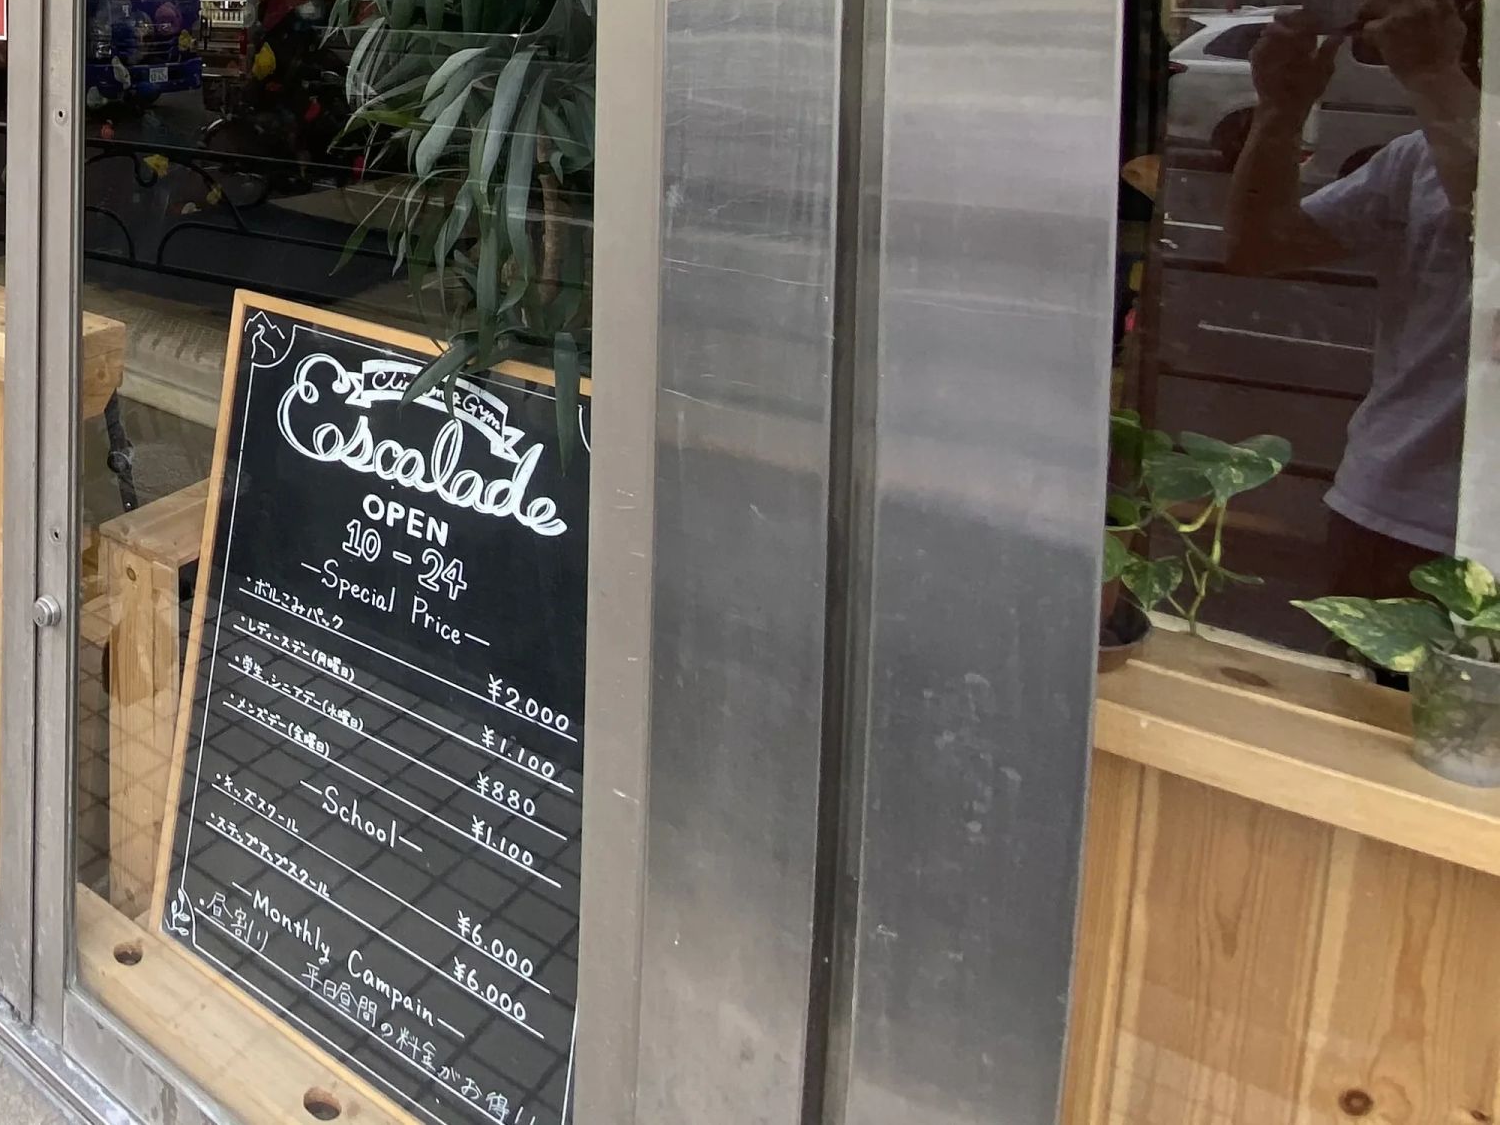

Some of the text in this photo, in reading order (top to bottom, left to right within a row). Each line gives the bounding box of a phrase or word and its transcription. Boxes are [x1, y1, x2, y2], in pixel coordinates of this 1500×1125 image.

[462, 394, 501, 430] Gym
[276, 352, 568, 536] Escalade
[362, 493, 449, 548] OPEN
[477, 771, 536, 817] ¥880
